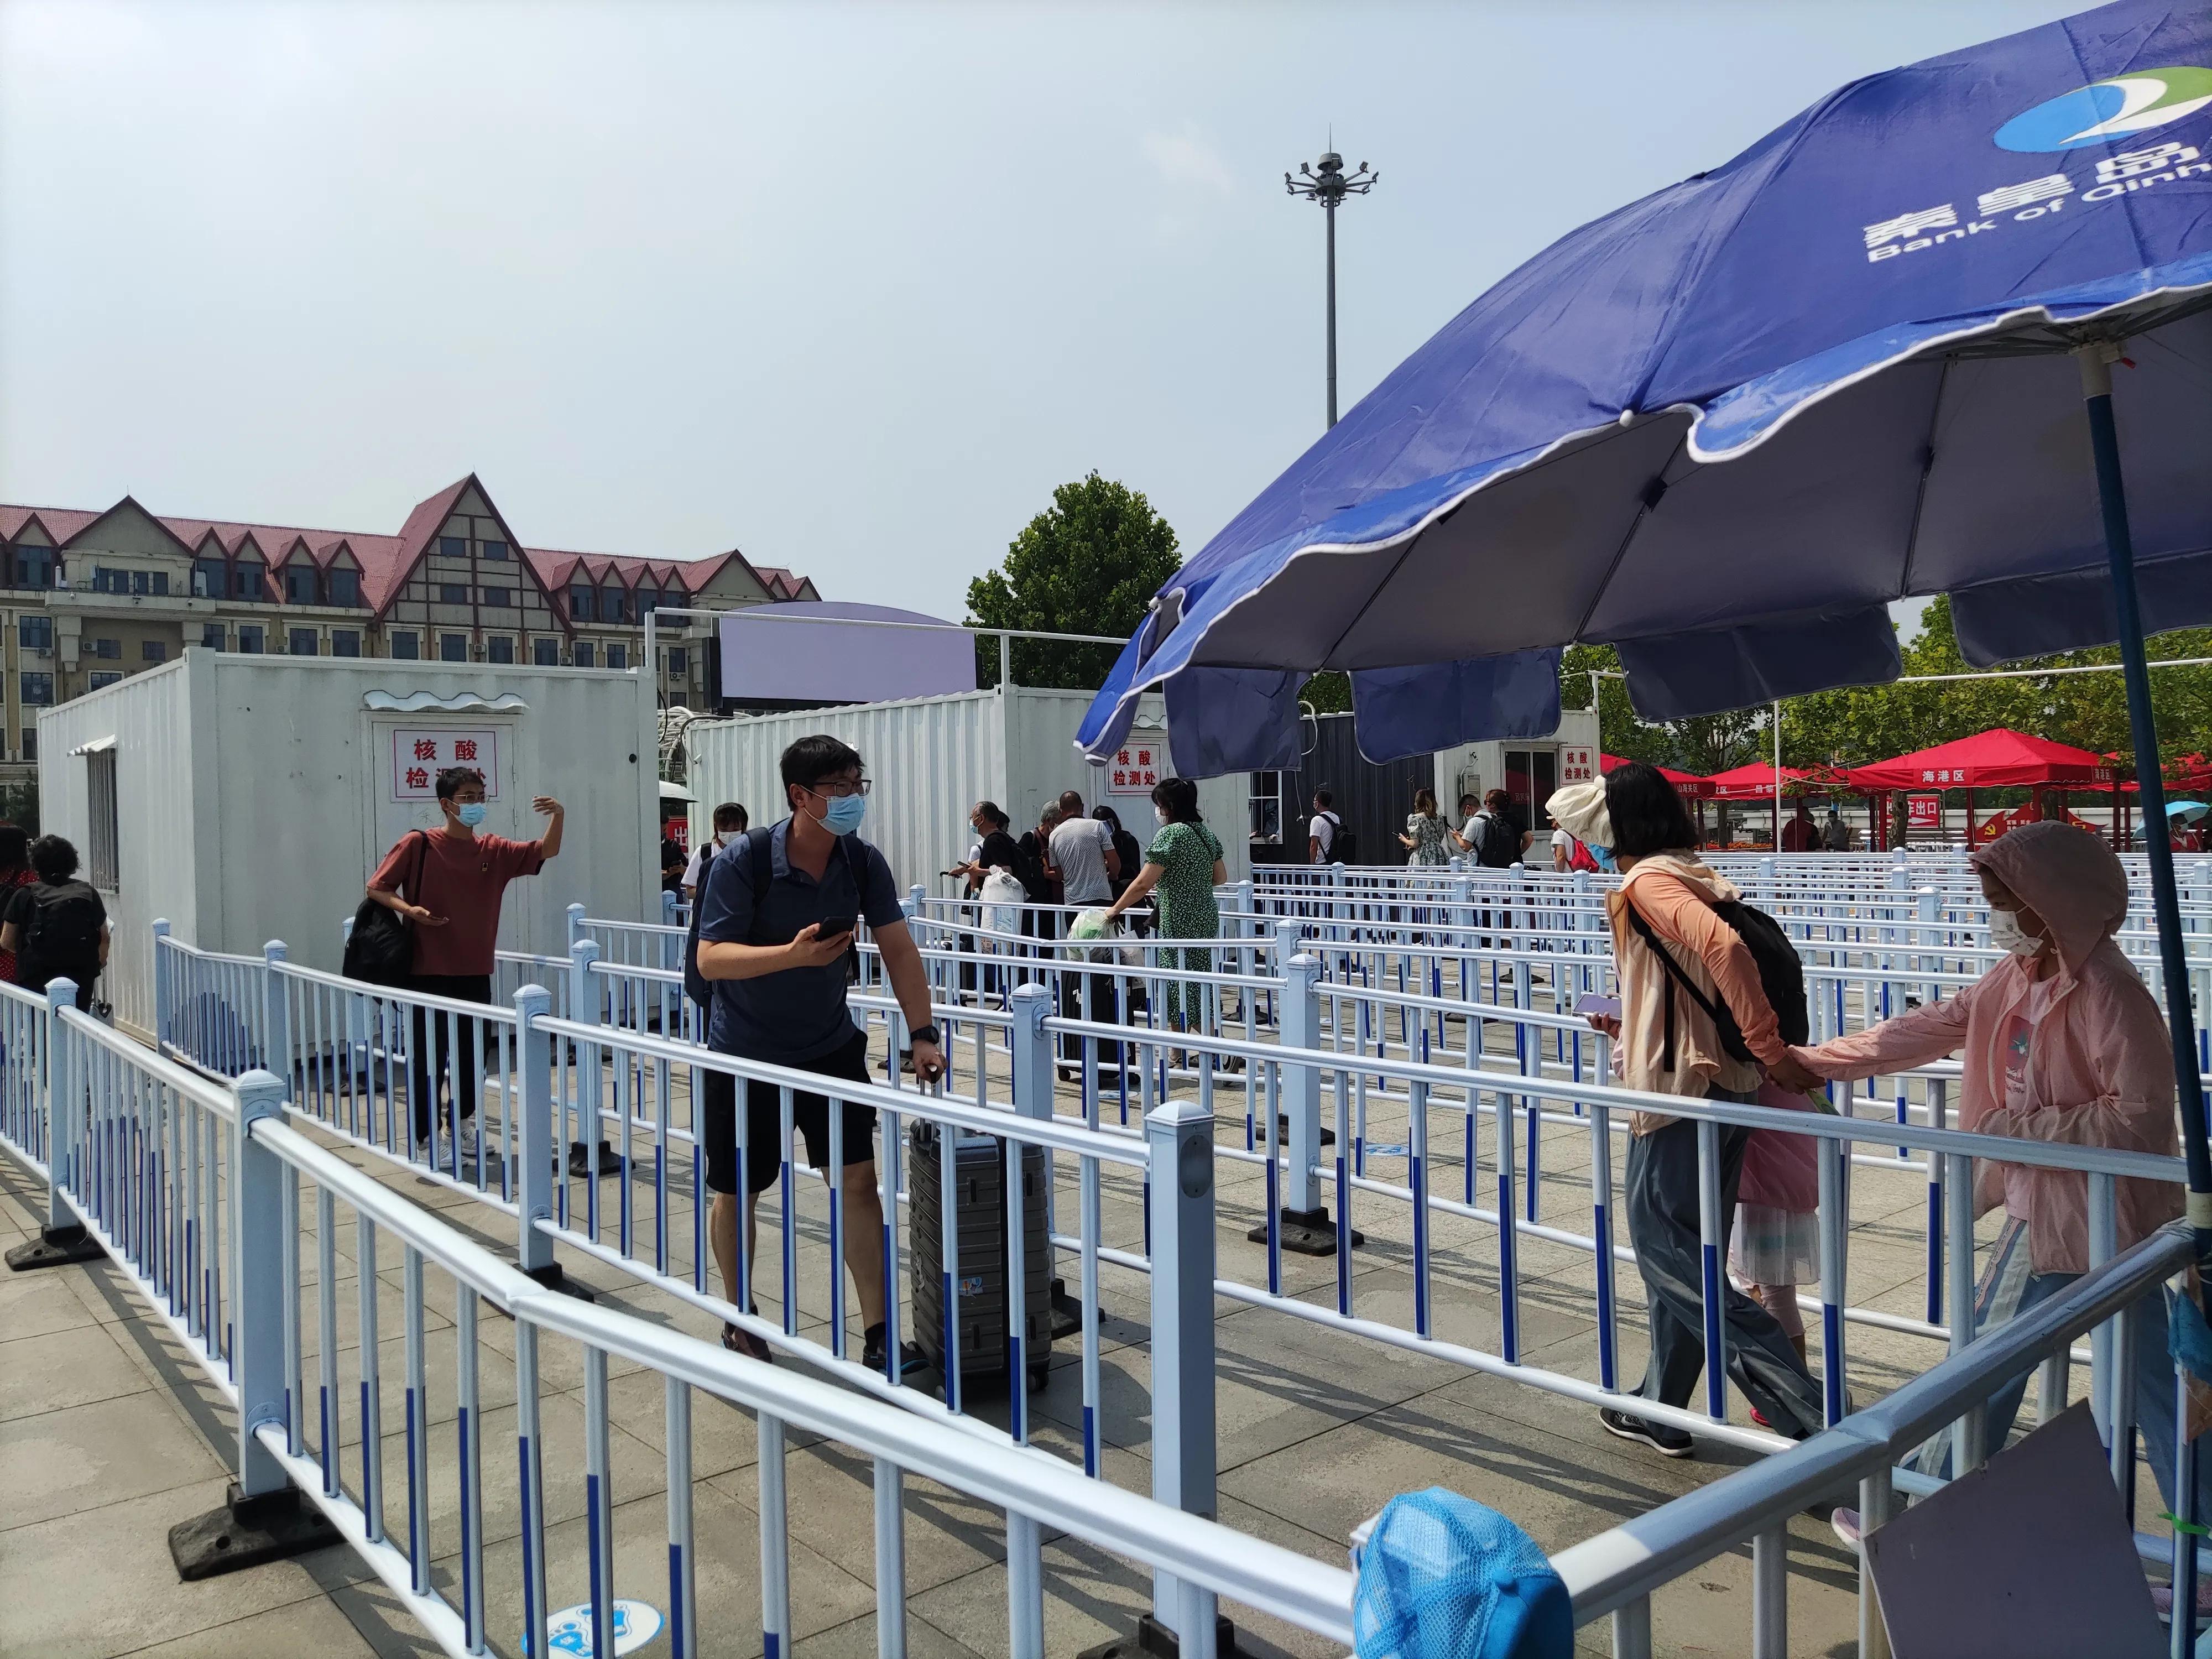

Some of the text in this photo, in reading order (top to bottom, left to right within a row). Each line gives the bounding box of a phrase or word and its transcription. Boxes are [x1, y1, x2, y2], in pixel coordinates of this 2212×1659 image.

[1863, 142, 2201, 249] 秦皇岛
[1868, 219, 1997, 263] Bank
[2013, 197, 2066, 221] of
[414, 739, 478, 761] 核酸
[1117, 749, 1151, 766] 核酸
[1567, 751, 1588, 764] 核酸
[1113, 770, 1156, 786] 检测处
[1564, 767, 1591, 780] 检测处
[1922, 770, 1965, 782] 海港区
[1677, 783, 1698, 793] 山海关区
[1755, 784, 1783, 794] 昌黎
